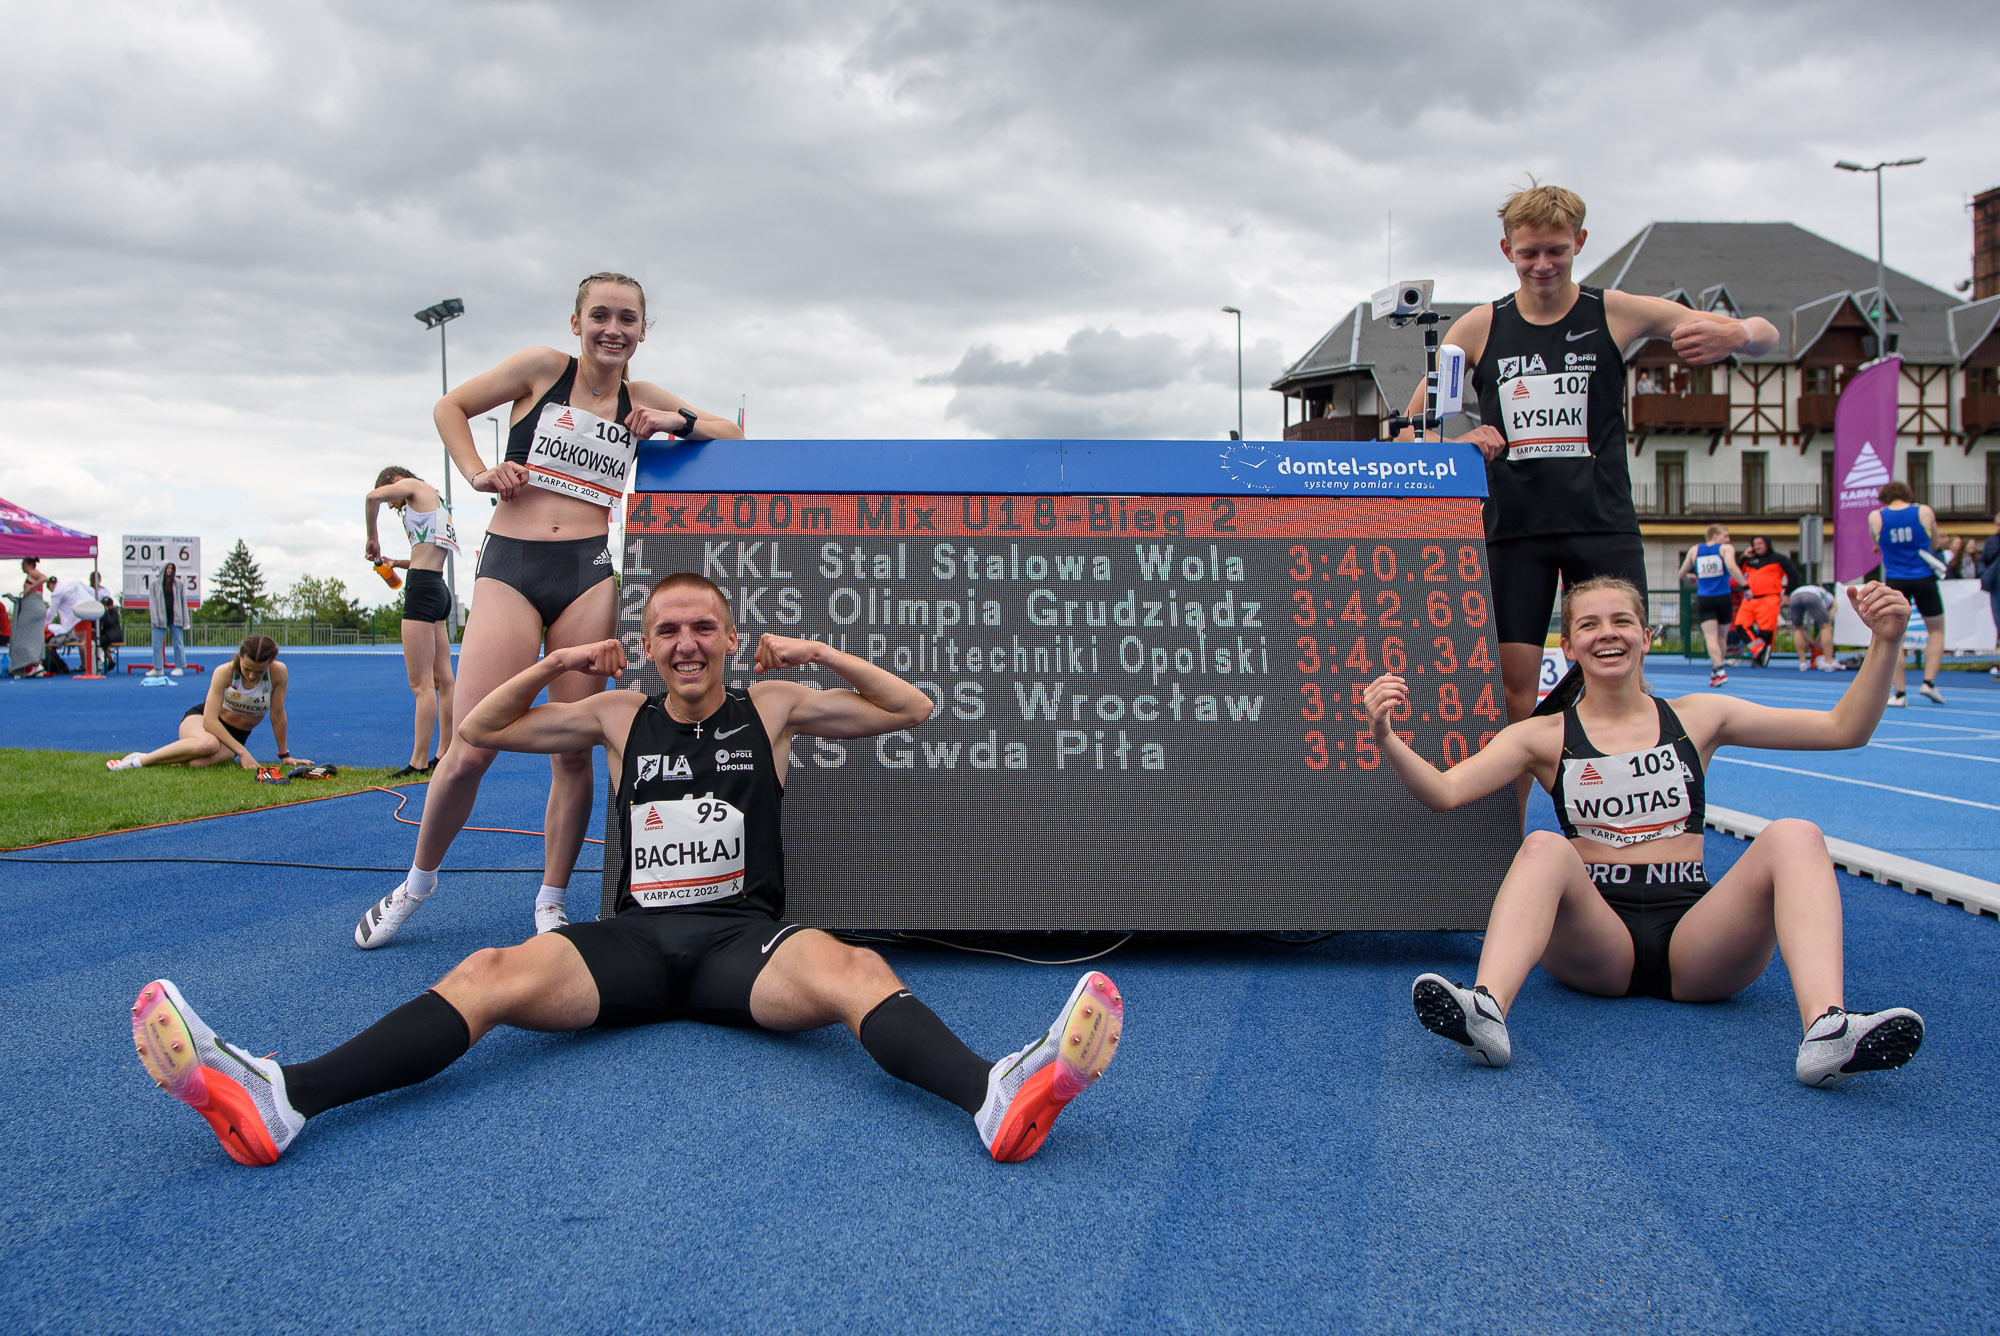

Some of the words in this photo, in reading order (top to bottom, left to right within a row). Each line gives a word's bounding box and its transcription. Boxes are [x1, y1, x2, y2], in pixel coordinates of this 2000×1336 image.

[1553, 376, 1587, 395] 102
[1512, 407, 1582, 430] ŁYSIAK
[595, 421, 632, 449] 104
[534, 436, 626, 481] ZIÓŁKOWSKA
[1516, 444, 1552, 454] KARPACZ
[1555, 444, 1576, 452] 2022
[1277, 456, 1458, 480] domtel-sport.pl
[537, 475, 579, 493] KARPACZ
[580, 487, 600, 500] 2022
[1303, 479, 1350, 490] systemy
[1840, 487, 1879, 500] KARPA
[629, 495, 832, 531] 4x400m
[857, 496, 937, 531] Mix
[962, 496, 1186, 538] U18-Bieg
[1211, 498, 1237, 533] 2
[178, 546, 190, 561] 6
[623, 538, 652, 576] 1
[703, 540, 792, 579] KKL
[819, 541, 907, 580] Stal
[932, 543, 1112, 581] Stalowa
[1135, 544, 1245, 582] Wola
[1288, 544, 1483, 582] 3:40.28
[620, 583, 651, 621] 2
[717, 587, 803, 625] KS
[828, 586, 1002, 637] Olimpia
[1026, 589, 1263, 640] Grudziądz
[1292, 589, 1488, 628] 3:42.69
[619, 632, 648, 671] 3
[868, 633, 1099, 674] Politechniki
[1118, 635, 1268, 685] Opolski
[1296, 636, 1496, 674] 3:46.34
[1013, 682, 1265, 722] Wrocław
[876, 729, 1029, 770] Gwda
[1056, 730, 1166, 770] Piła
[720, 763, 755, 771] OPOLSKIE
[1628, 749, 1675, 779] 103
[697, 802, 728, 824] 95
[1573, 786, 1681, 819] WOJTAS
[1591, 827, 1638, 844] KARPACZ
[634, 837, 741, 870] BACHŁAJ
[1645, 862, 1703, 884] NIKE
[643, 889, 691, 901] KARPACZ
[693, 885, 720, 898] 2022
